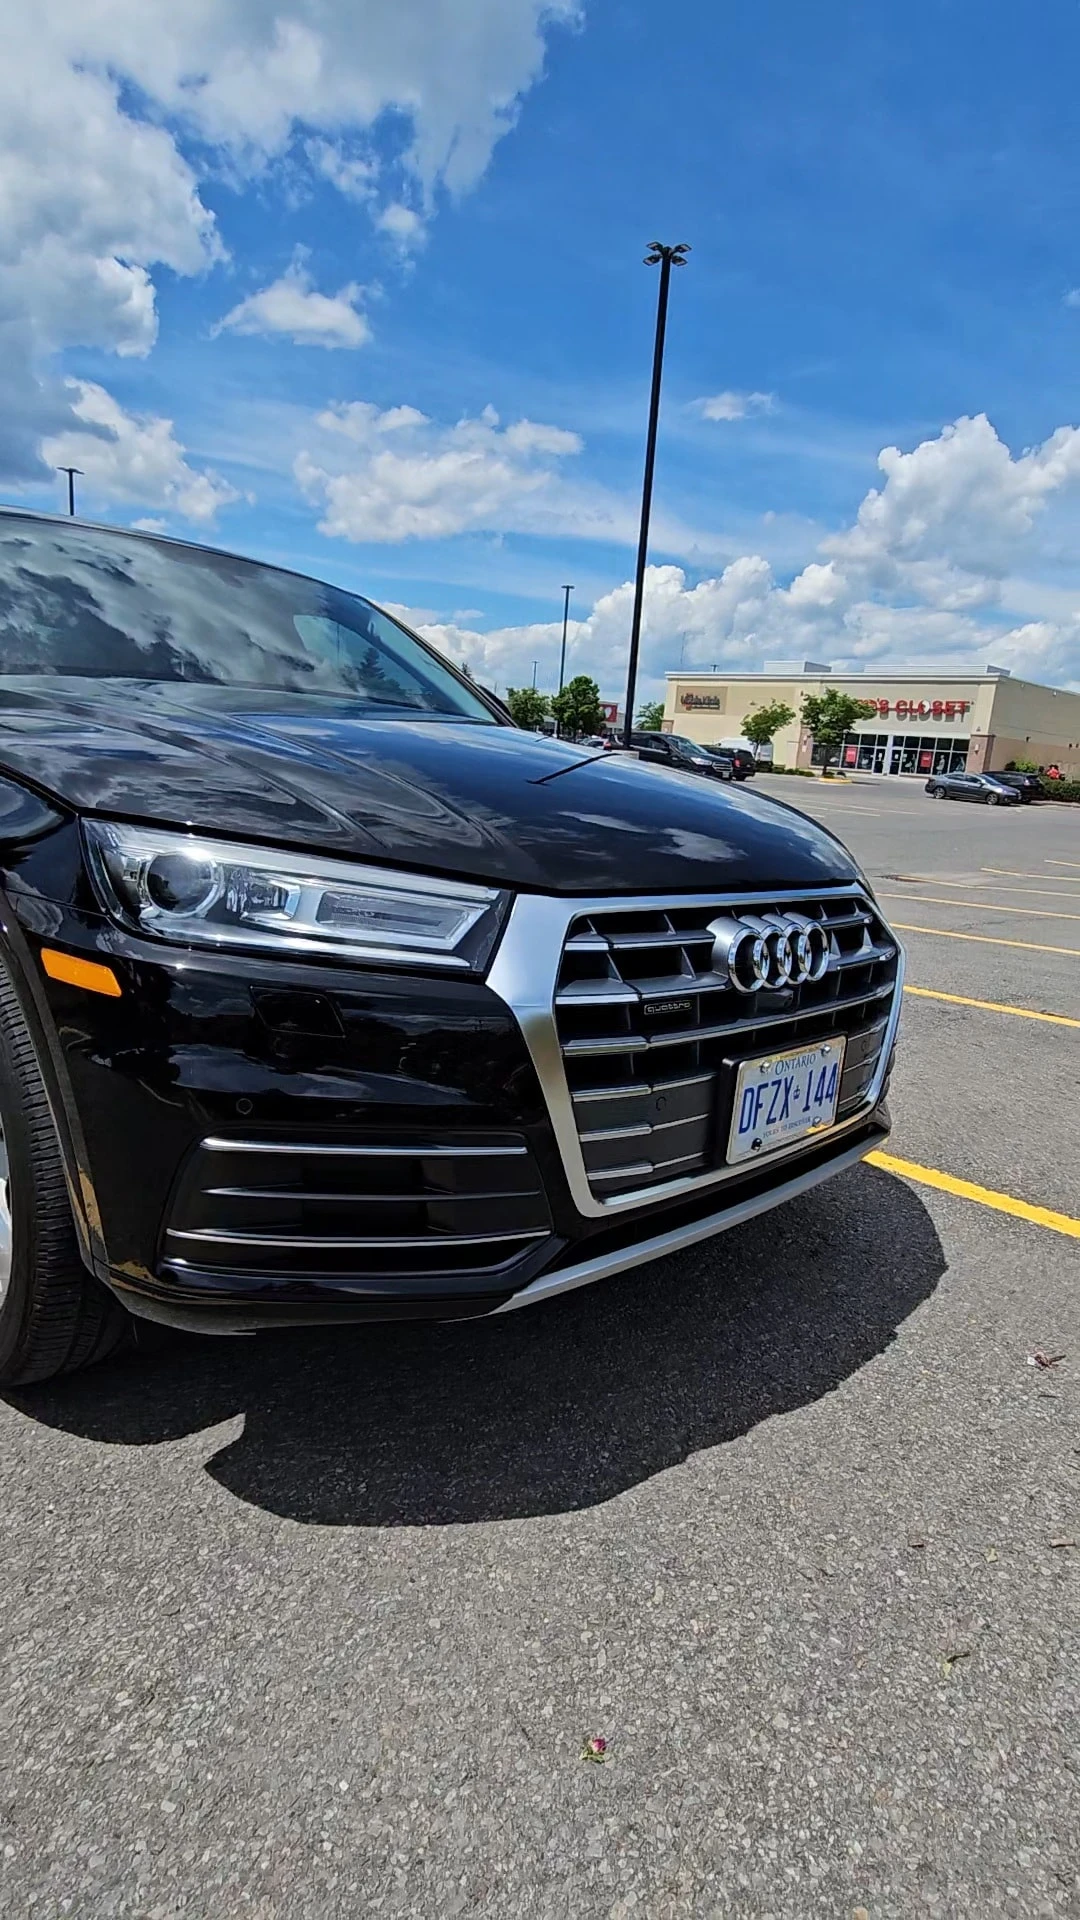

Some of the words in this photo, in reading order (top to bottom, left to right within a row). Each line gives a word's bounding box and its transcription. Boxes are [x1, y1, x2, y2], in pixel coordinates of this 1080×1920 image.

[895, 700, 970, 716] CLOSET
[647, 1002, 691, 1014] quattro
[775, 1054, 816, 1075] ONTARIO
[739, 1075, 794, 1134] DFZX
[802, 1062, 838, 1113] 144
